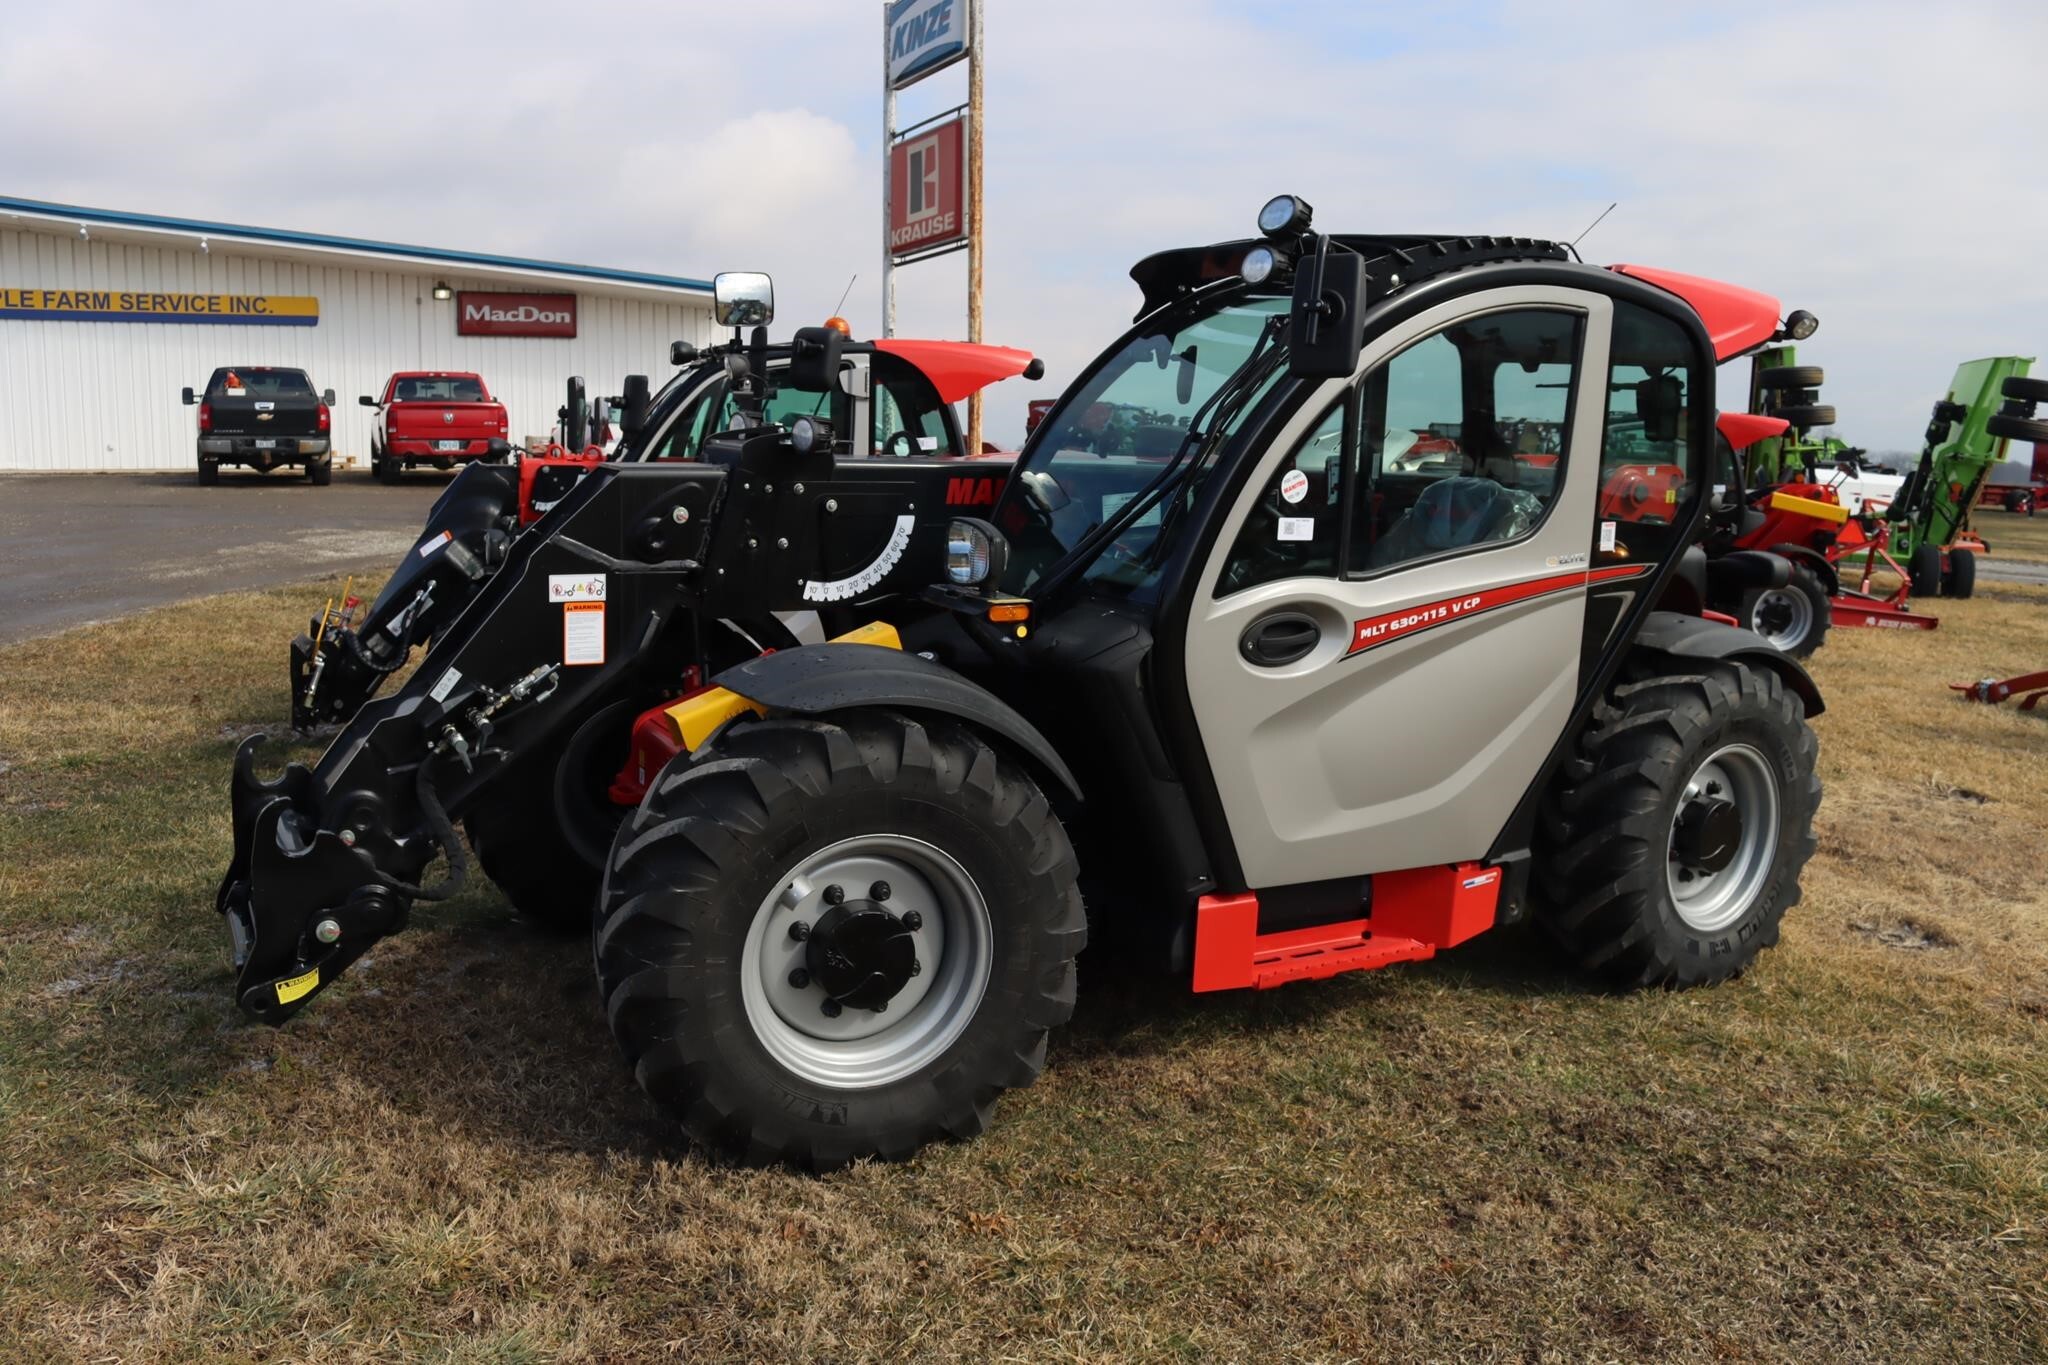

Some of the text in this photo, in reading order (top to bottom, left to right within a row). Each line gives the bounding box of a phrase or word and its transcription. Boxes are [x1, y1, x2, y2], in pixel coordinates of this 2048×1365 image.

[892, 0, 953, 61] KINZE
[892, 211, 955, 247] KRAUSE
[43, 291, 111, 310] FARM
[119, 293, 221, 313] SERVICE
[229, 296, 274, 314] INC.
[465, 304, 571, 323] MacDon
[1361, 597, 1480, 639] MLT 630-115 V CP
